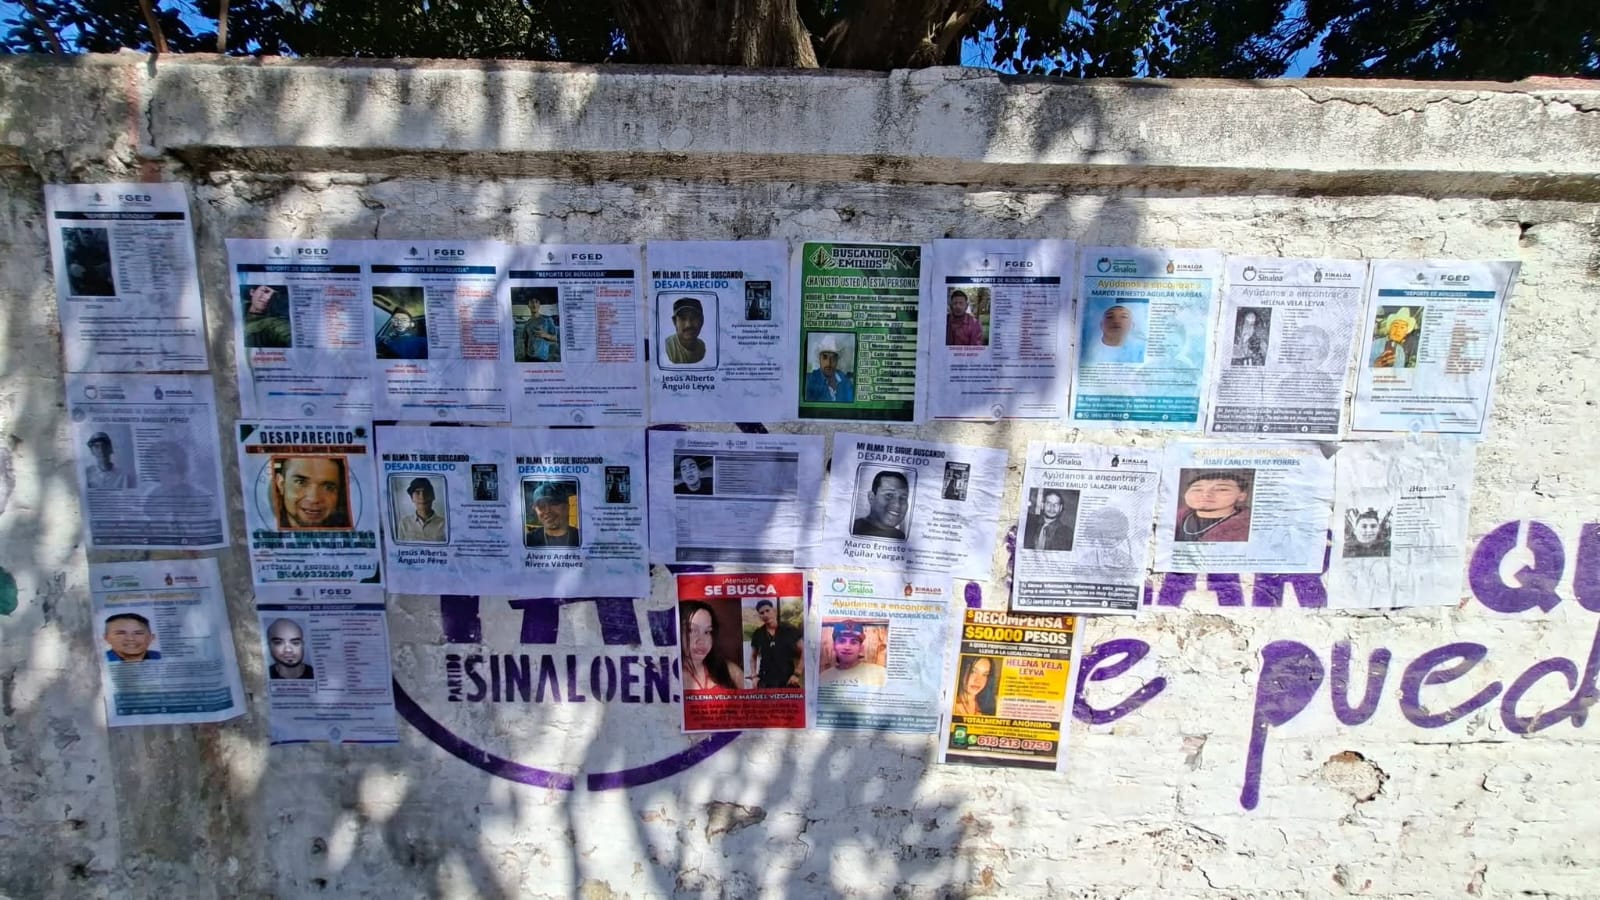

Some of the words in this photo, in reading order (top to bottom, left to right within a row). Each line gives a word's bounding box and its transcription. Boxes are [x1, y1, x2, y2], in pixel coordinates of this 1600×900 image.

[832, 248, 890, 258] BUSCANDO
[652, 271, 661, 279] MI
[663, 271, 681, 279] ALMA
[683, 271, 690, 279] TE
[692, 271, 709, 279] SIGUE
[711, 271, 743, 279] BUSCANDO
[821, 276, 839, 287] VISTO
[841, 277, 860, 287] USTED
[862, 277, 868, 288] A
[869, 278, 885, 288] ESTA
[662, 375, 683, 383] Jesús
[692, 384, 715, 392] Leyva
[260, 431, 353, 444] DESAPARECIDO
[857, 442, 865, 450] MI
[866, 443, 884, 452] ALMA
[886, 445, 893, 453] TE
[895, 446, 912, 455] SIGUE
[913, 448, 946, 458] BUSCANDO
[411, 454, 418, 462] TE
[857, 452, 930, 466] DESAPARECIDO
[1057, 458, 1082, 466] Sinaloa
[385, 463, 456, 471] DESAPARECIDO
[1042, 471, 1085, 481] Ayúdanos
[1095, 474, 1139, 482] encontrar
[844, 540, 871, 550] Marco
[874, 543, 906, 553] Ernesto
[398, 549, 418, 557] Jesús
[843, 549, 874, 560] Aguilar
[876, 552, 905, 562] Vargas
[551, 561, 583, 569] Vázquez
[705, 586, 722, 595] SE
[727, 585, 777, 595] BUSCA
[848, 586, 873, 594] Sinaloa
[974, 611, 1063, 629] RECOMPENSA
[1024, 632, 1067, 644] PESOS
[1006, 659, 1039, 668] HELENA
[1041, 661, 1063, 669] VELA
[1019, 668, 1044, 676] LEYVA
[446, 654, 463, 702] PARTIDO
[963, 717, 1010, 726] TOTALMENTE
[978, 736, 999, 747] 618
[1000, 738, 1020, 749] 213
